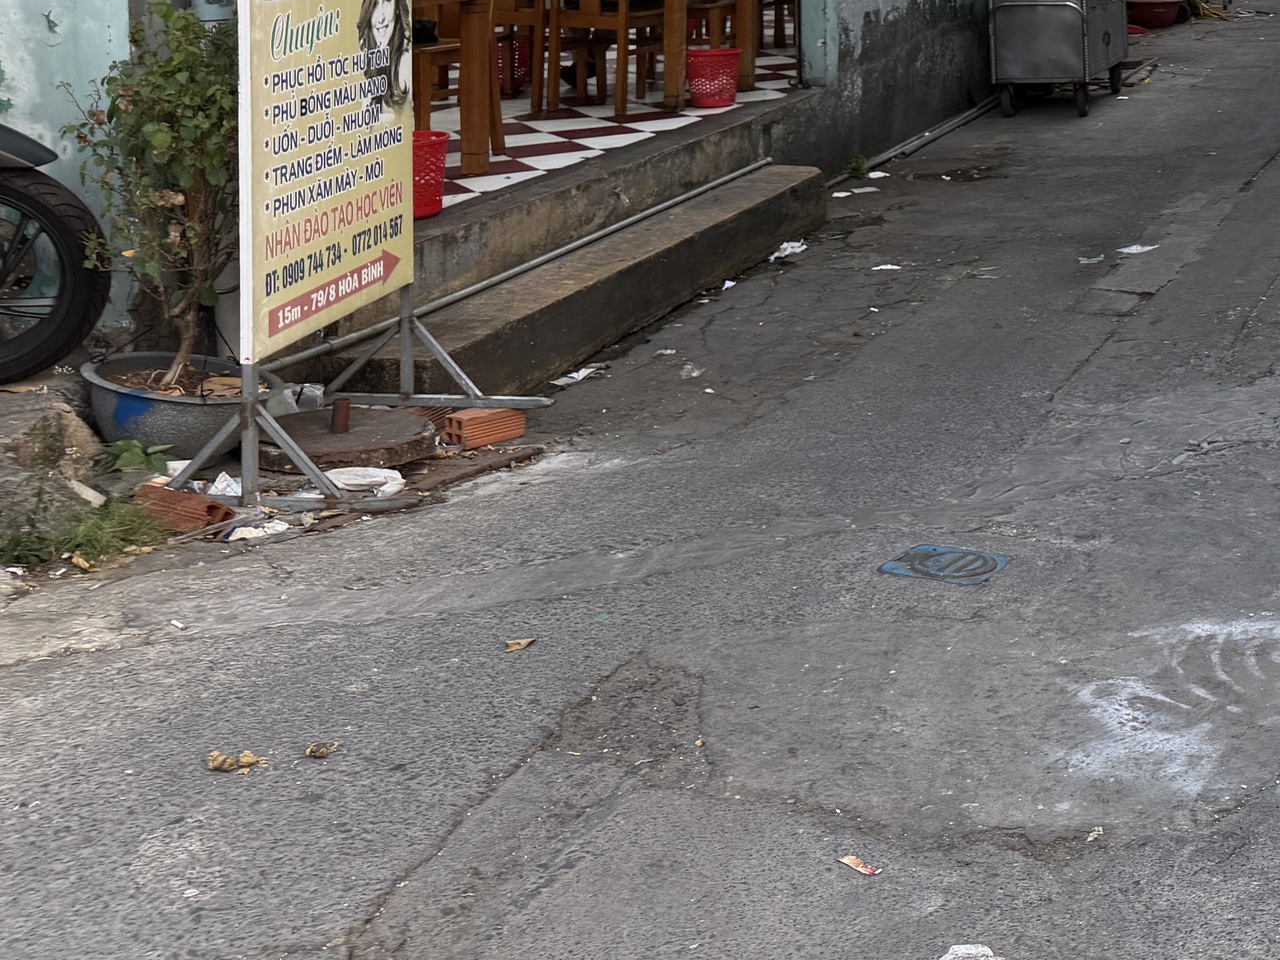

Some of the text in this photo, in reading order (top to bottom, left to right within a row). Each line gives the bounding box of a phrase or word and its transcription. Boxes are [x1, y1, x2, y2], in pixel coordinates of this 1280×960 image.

[272, 42, 389, 94] PHỤC HỒI TÓC HƯ TỔN
[272, 75, 387, 125] PHỦ BÓNG MÀU NANO
[273, 105, 380, 156] UỐN DUỖI NHUỘM
[273, 126, 403, 187] TRANG ĐIỂM LÀM MÓNG
[273, 159, 384, 218] PHUN XĂM MÀY MÔI
[265, 178, 403, 261] NHẬN ĐÀO TẠO HỌC VIÊN
[265, 214, 403, 297] ĐT: 0909 744 734 0772 014 567
[277, 260, 384, 328] 15m 79/8 HÒA BÌNH
